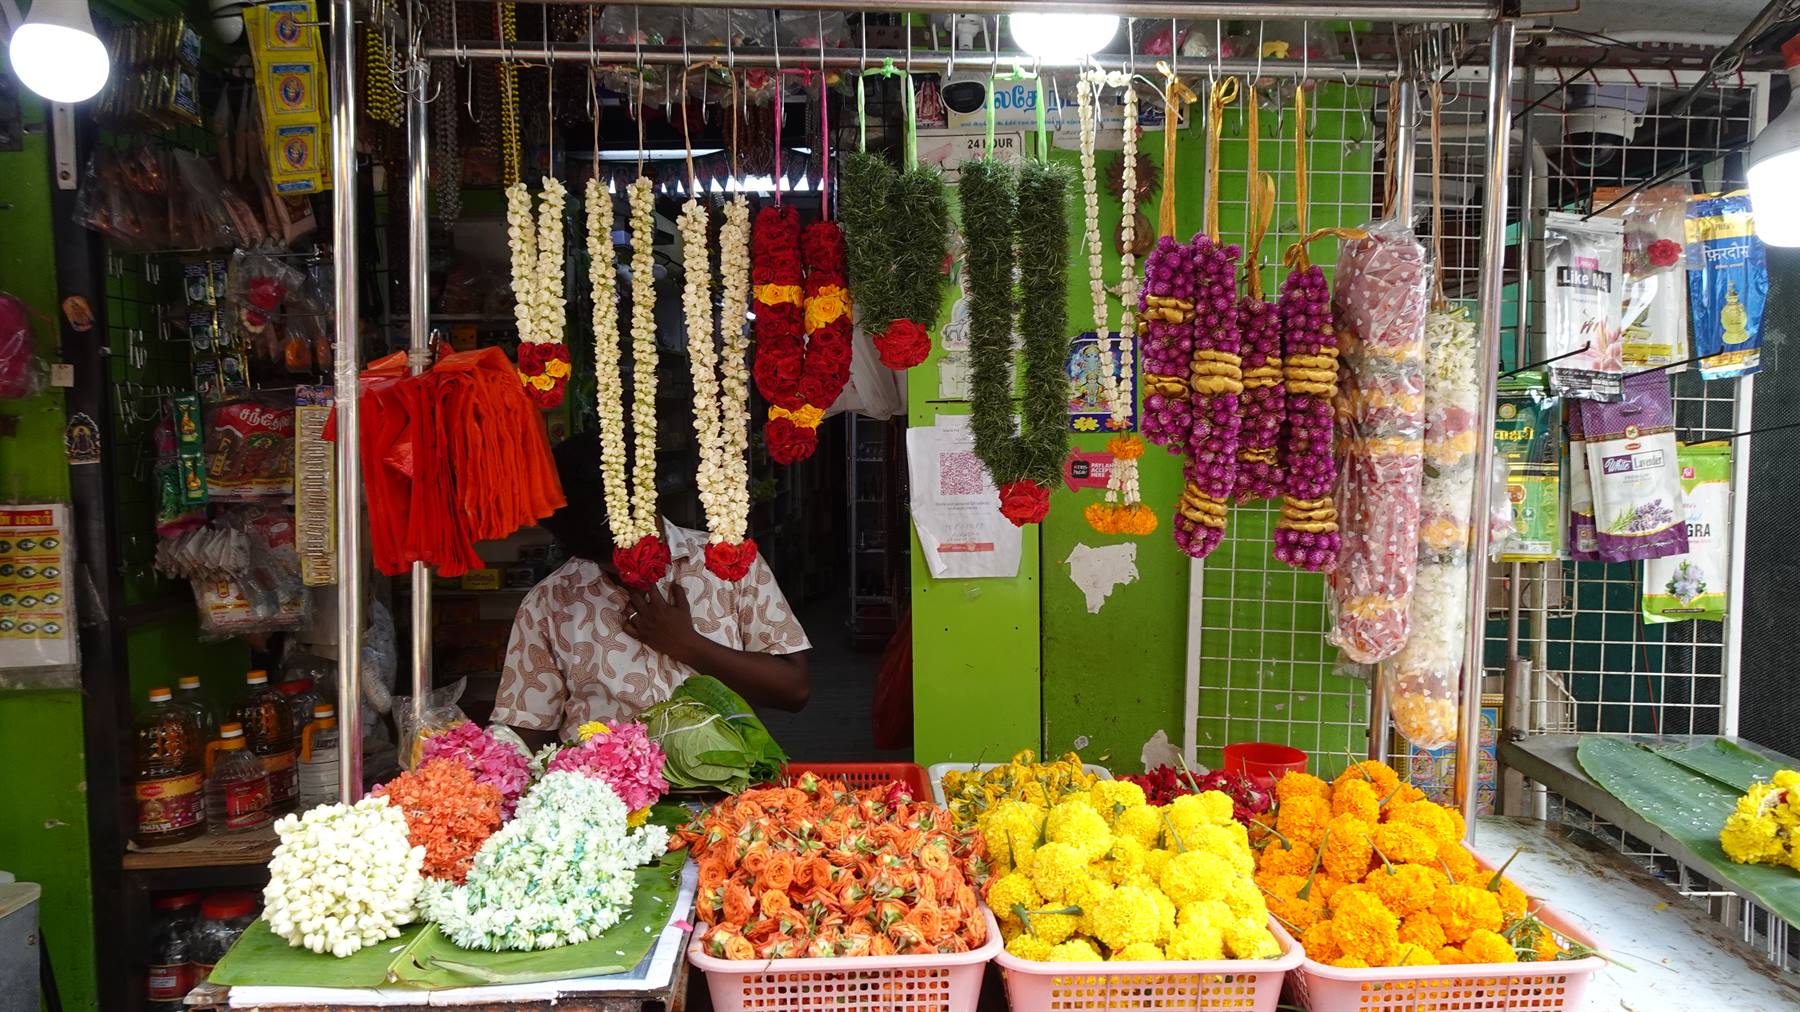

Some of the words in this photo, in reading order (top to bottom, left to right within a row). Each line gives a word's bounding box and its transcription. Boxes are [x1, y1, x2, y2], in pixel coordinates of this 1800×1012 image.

[968, 139, 980, 149] 24
[1563, 269, 1589, 285] Like
[1592, 272, 1608, 290] Me
[1604, 458, 1631, 472] White
[1634, 454, 1662, 468] Lavender
[1687, 523, 1711, 537] GRA
